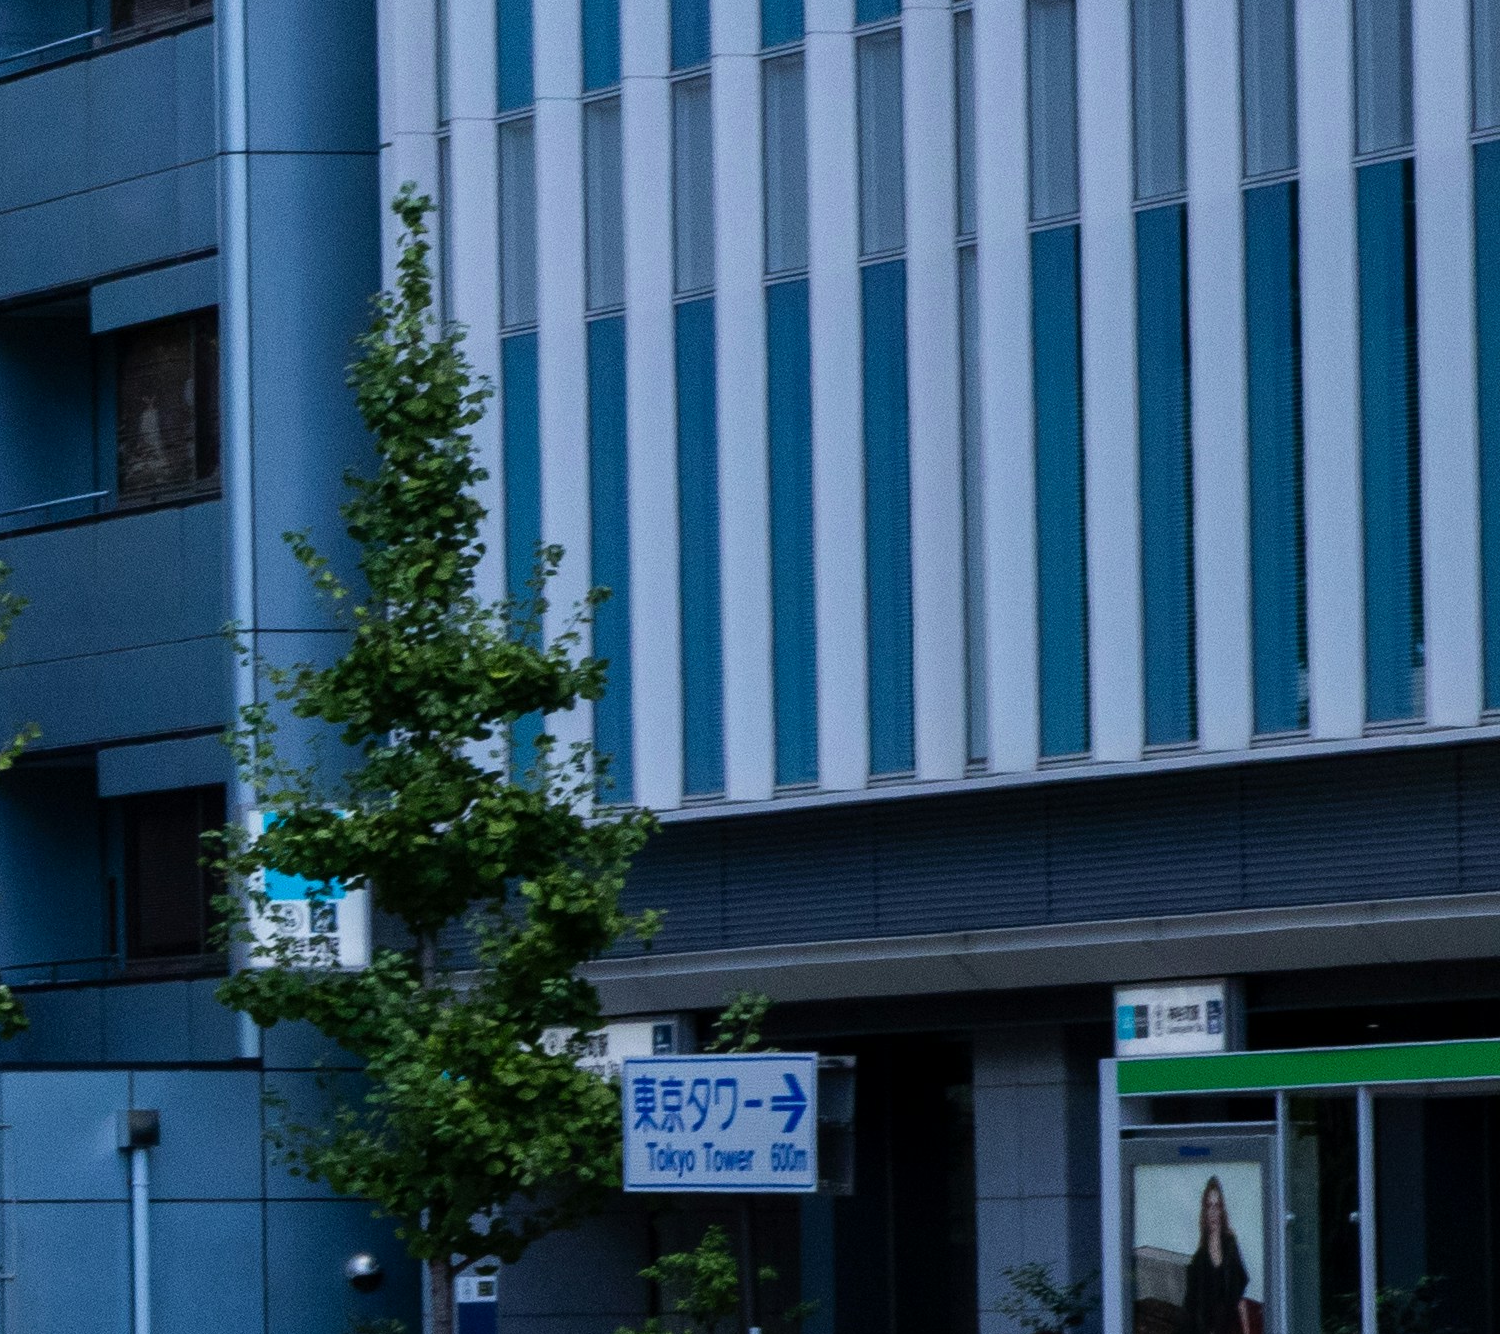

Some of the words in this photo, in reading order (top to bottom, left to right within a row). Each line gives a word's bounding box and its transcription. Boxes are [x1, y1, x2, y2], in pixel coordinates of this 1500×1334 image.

[632, 1074, 764, 1133] 東京タワー
[646, 1141, 697, 1179] Tokyo
[703, 1141, 756, 1172] Tower
